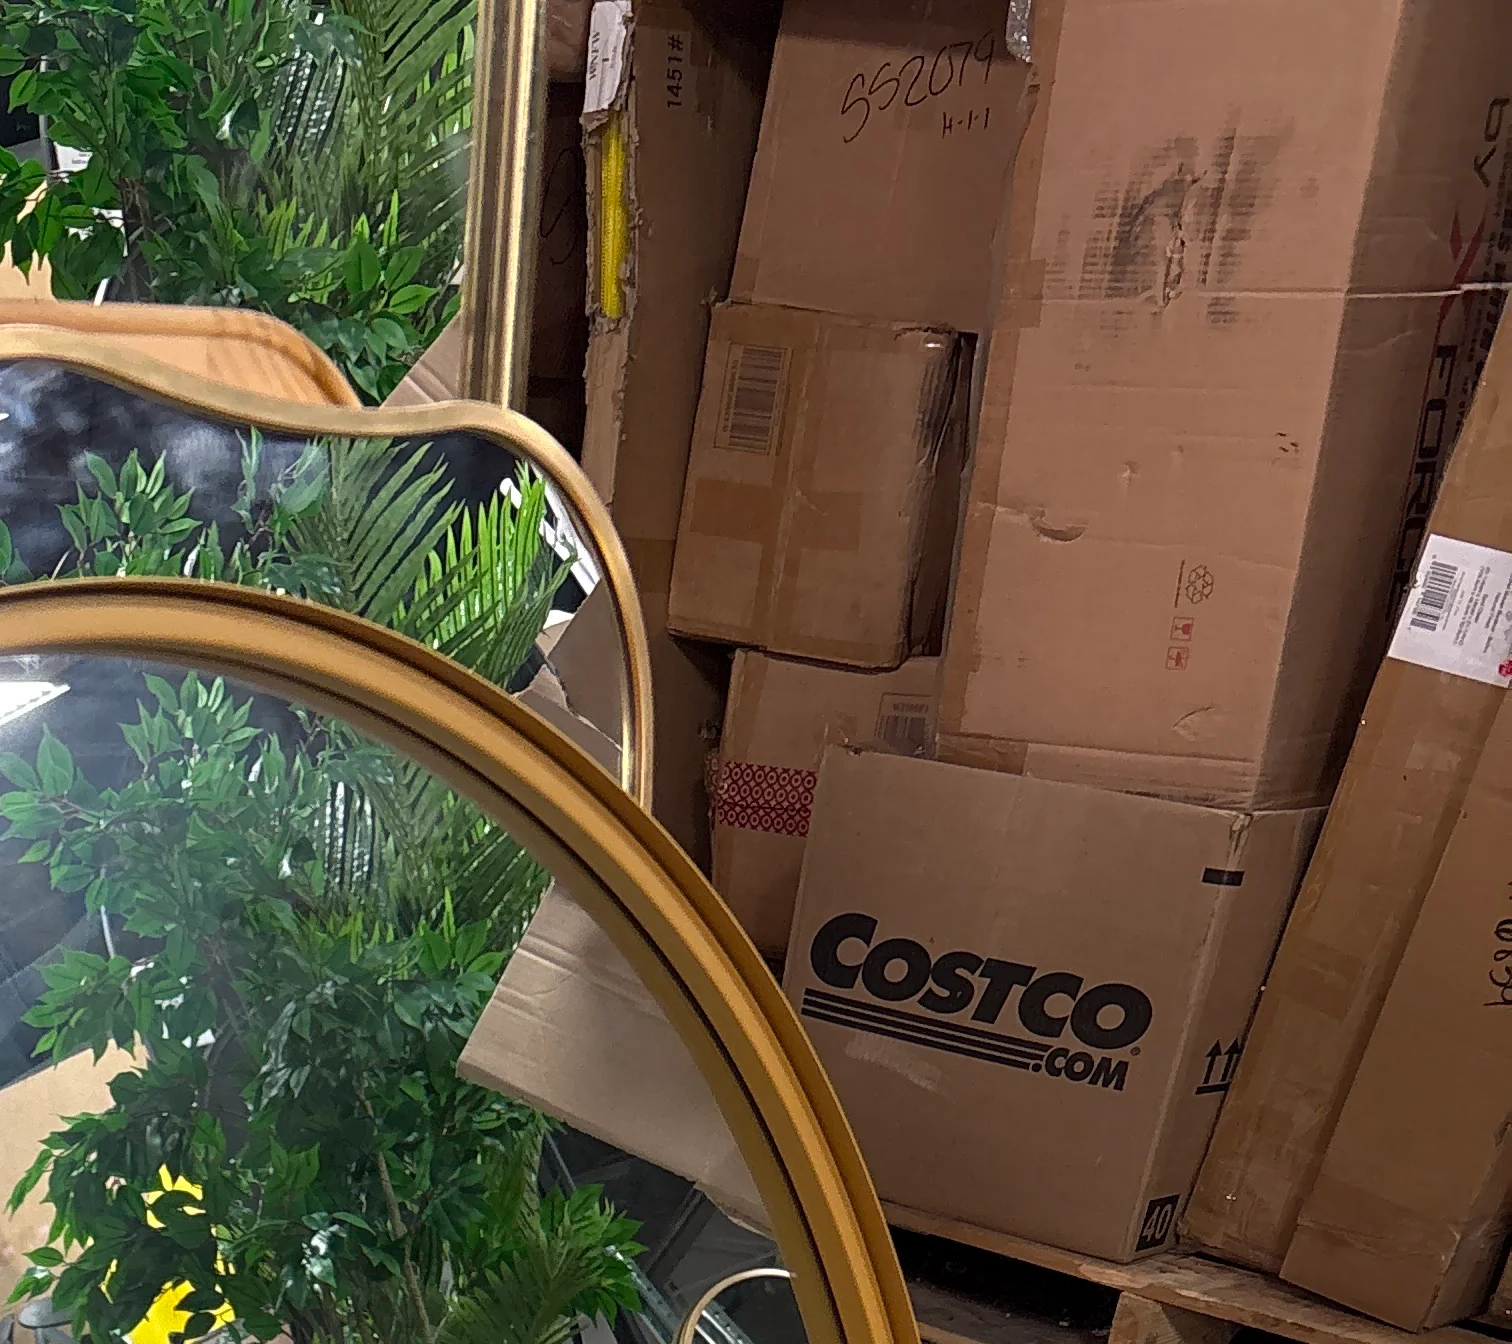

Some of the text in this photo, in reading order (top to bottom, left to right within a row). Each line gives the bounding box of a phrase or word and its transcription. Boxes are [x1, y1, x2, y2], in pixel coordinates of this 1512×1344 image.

[667, 34, 683, 107] 1451#
[810, 912, 1153, 1050] COSTCO
[1141, 1203, 1172, 1242] 40
